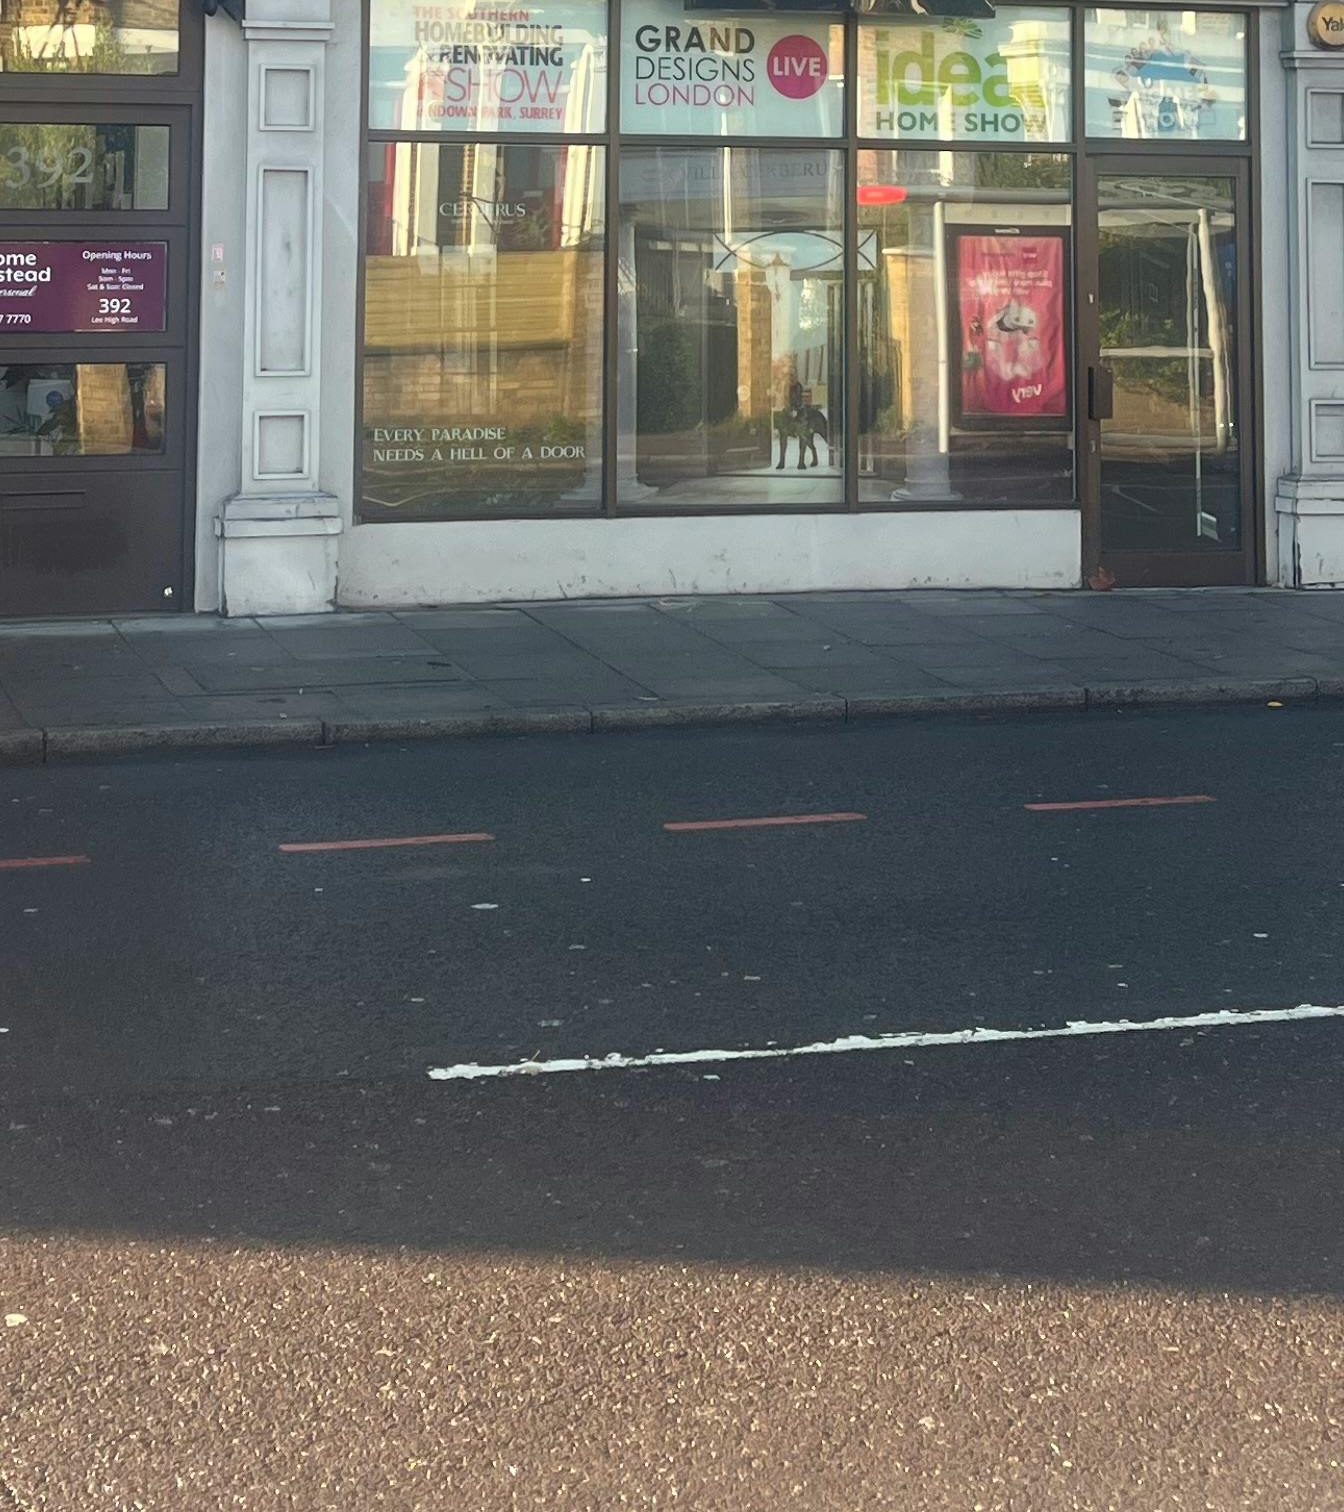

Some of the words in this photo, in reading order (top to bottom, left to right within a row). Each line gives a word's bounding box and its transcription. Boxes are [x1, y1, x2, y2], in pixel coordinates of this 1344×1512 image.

[414, 5, 442, 20] THE
[414, 21, 564, 46] HOMEBUILDING
[634, 23, 756, 55] GRAND
[634, 55, 756, 82] DESIGNS
[772, 54, 822, 78] LIVE
[447, 67, 564, 104] SHOW
[634, 83, 755, 107] LONDON
[519, 106, 564, 120] SURREY
[4, 145, 94, 189] 392
[82, 250, 122, 262] Opening
[123, 250, 152, 260] Hours
[99, 298, 131, 314] 392
[5, 313, 32, 325] 7770
[373, 428, 425, 442] EVERY
[431, 426, 507, 442] PARADISE
[373, 448, 425, 462] NEEDS
[431, 448, 444, 461] A
[450, 447, 487, 461] HELL
[493, 446, 516, 460] OF
[521, 446, 534, 460] A
[540, 445, 586, 459] DOOR
